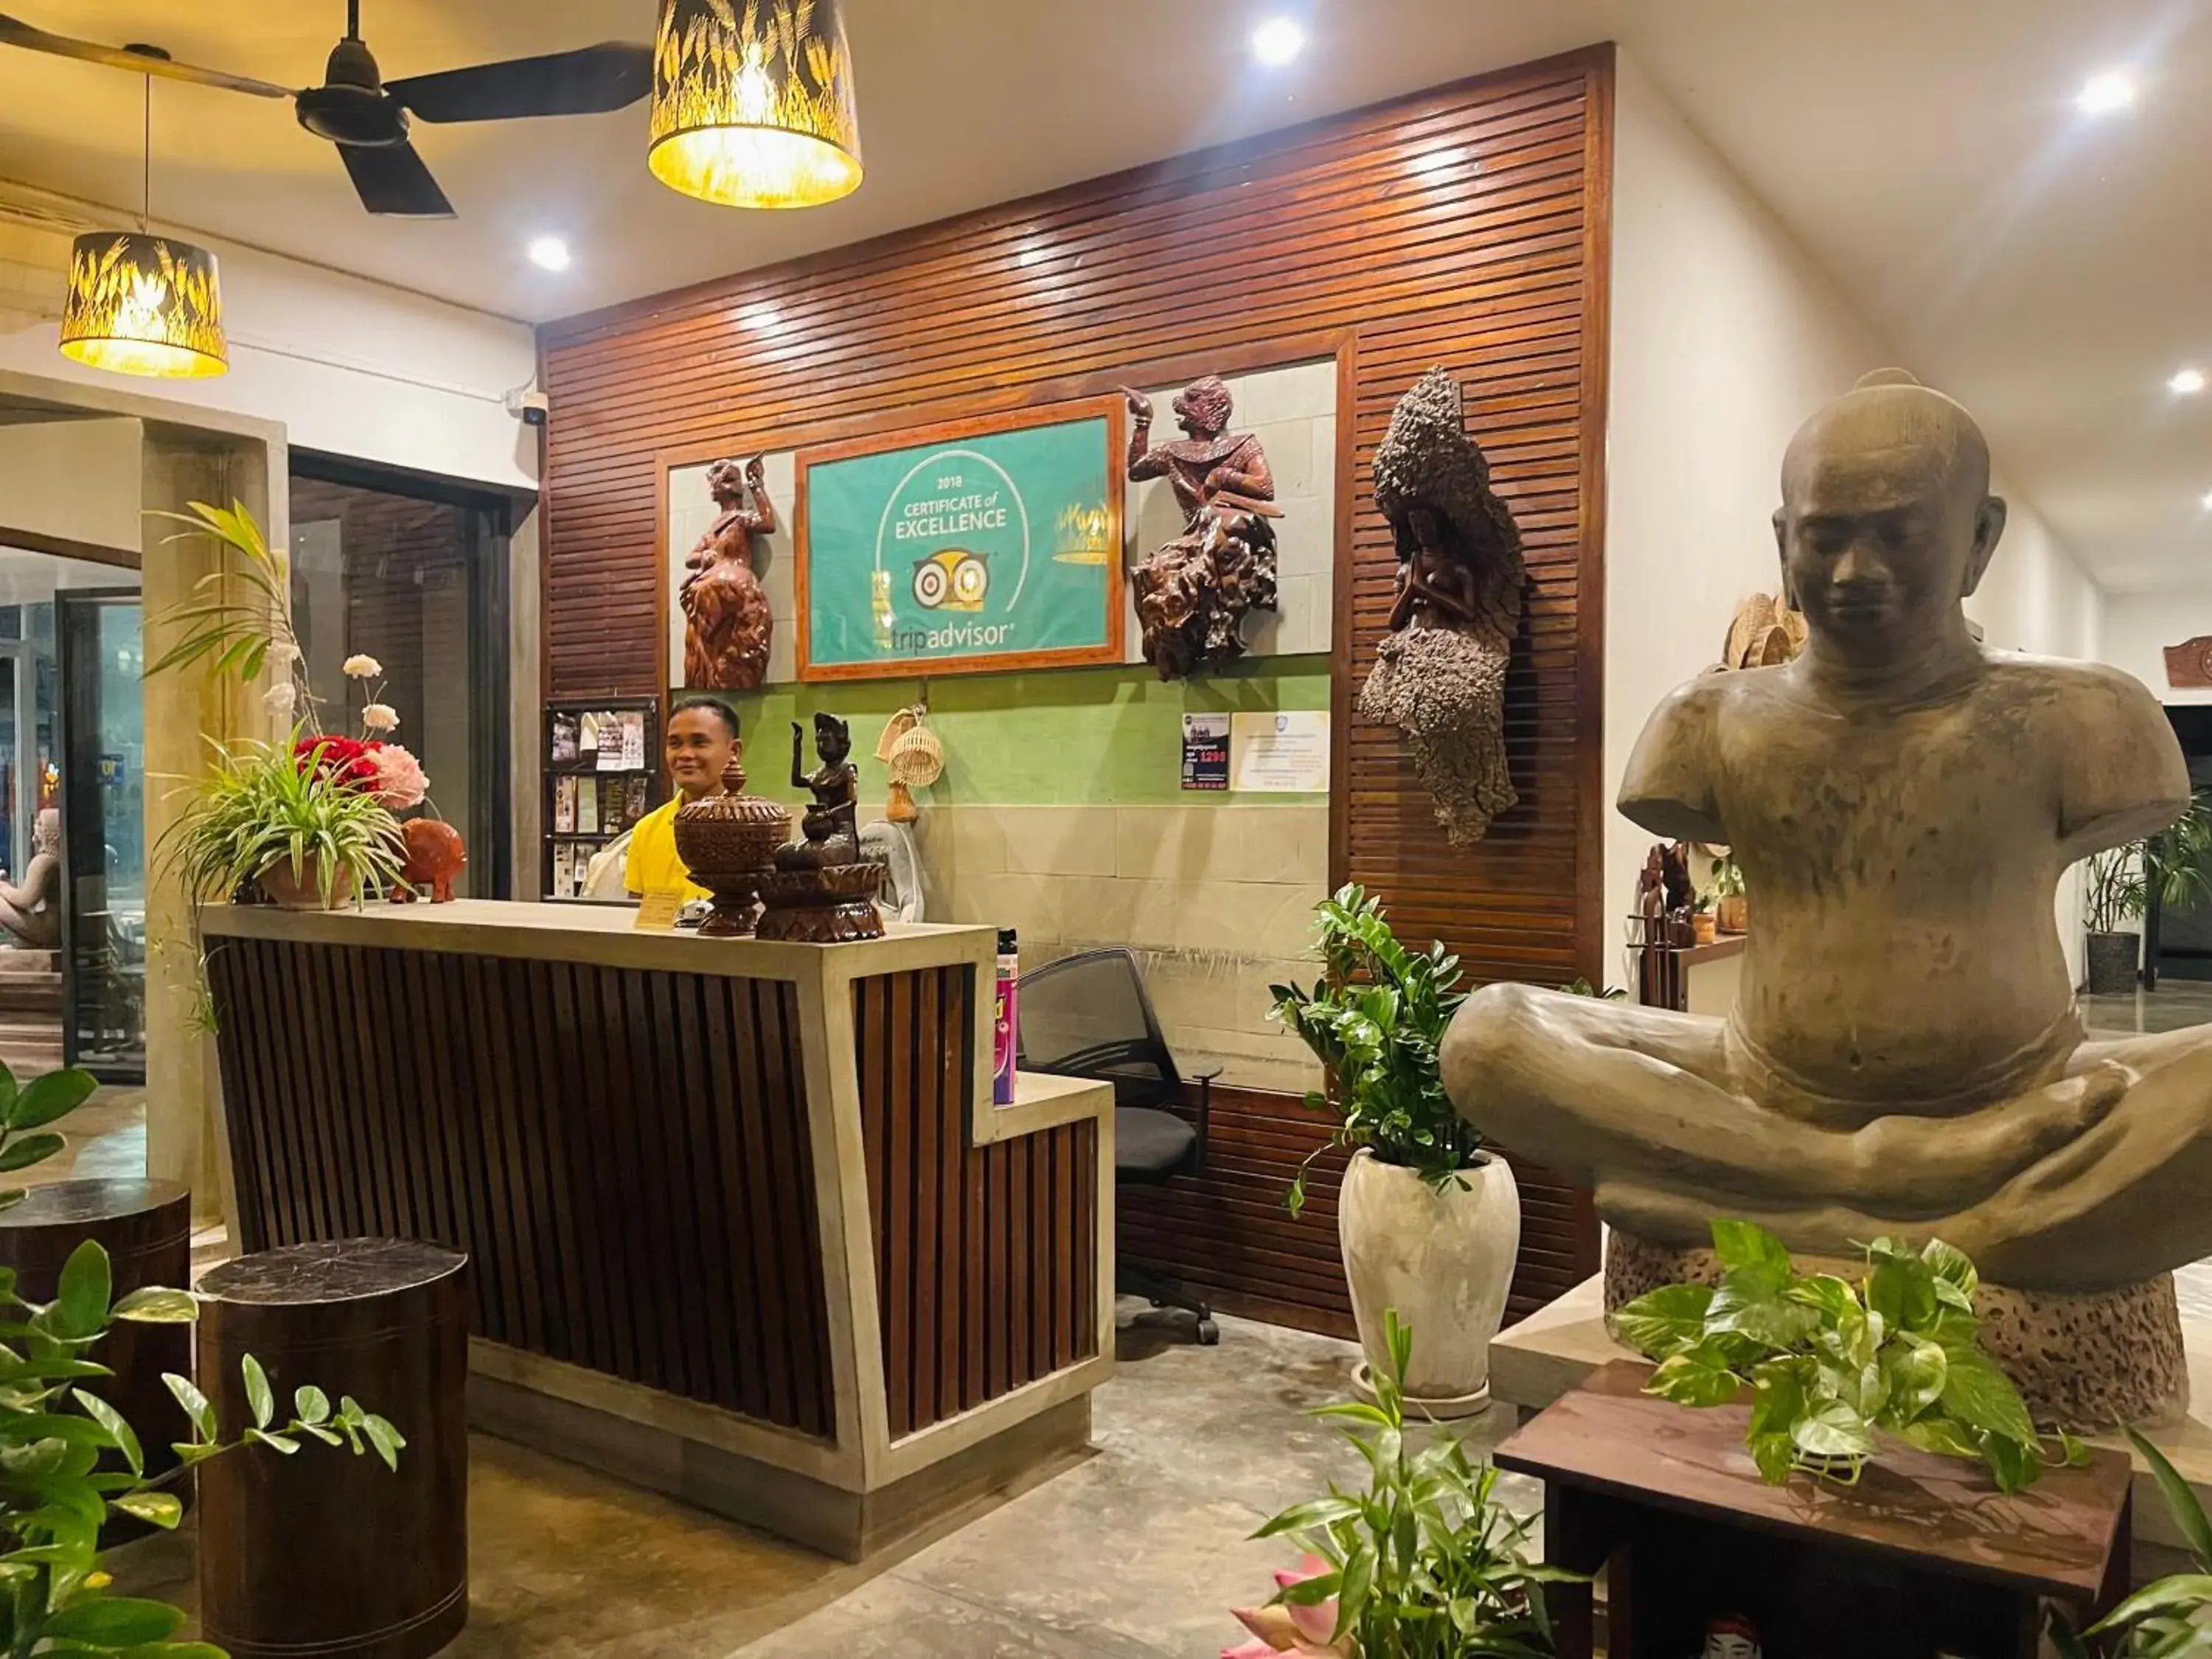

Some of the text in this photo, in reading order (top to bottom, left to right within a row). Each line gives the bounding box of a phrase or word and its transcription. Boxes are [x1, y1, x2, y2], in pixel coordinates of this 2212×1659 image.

[937, 476, 962, 490] 2018
[904, 491, 998, 517] CERTIFICATE of
[895, 509, 1006, 539] EXCELLENCE
[891, 620, 1008, 655] tripadvisor
